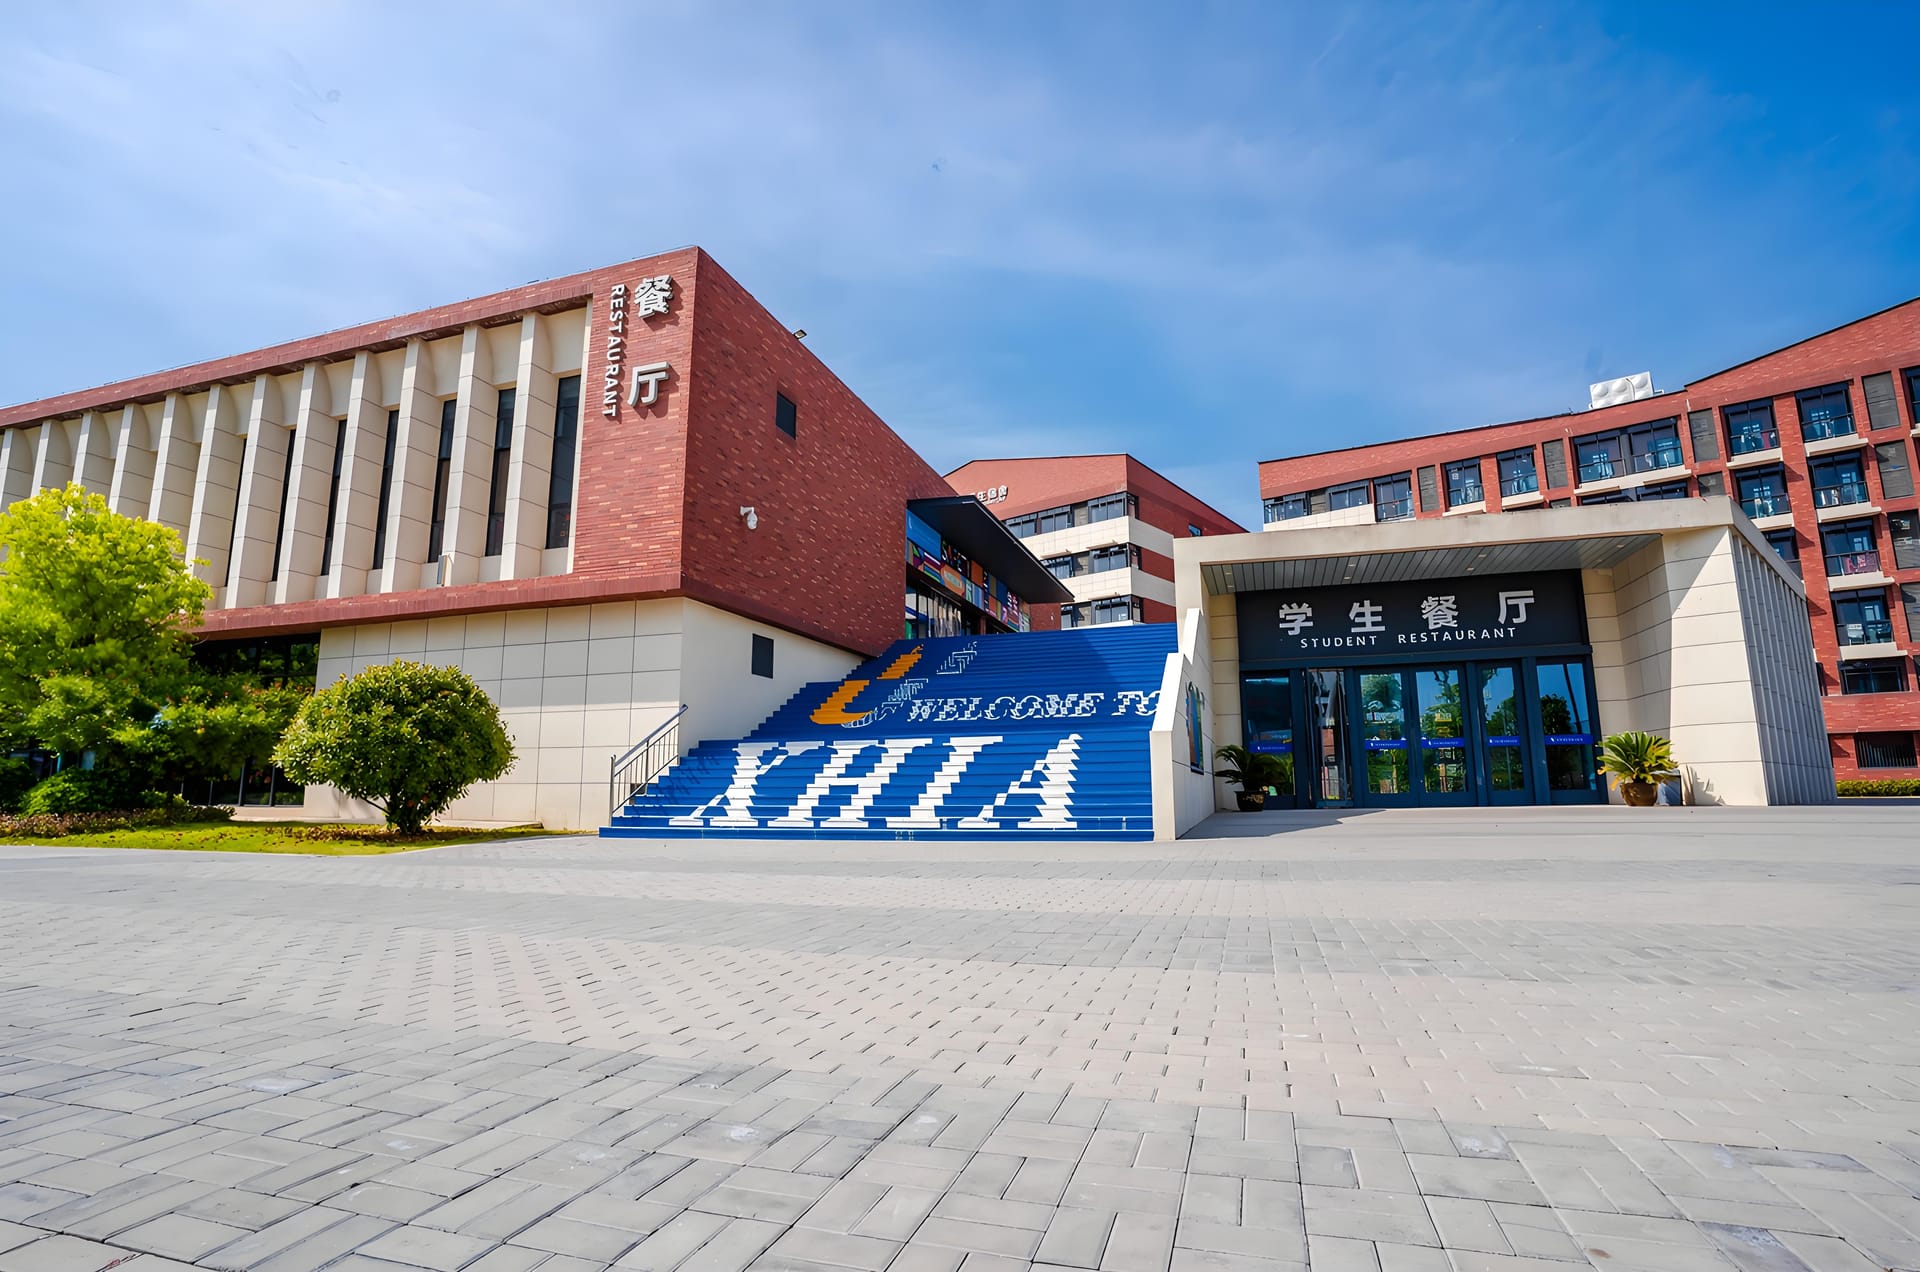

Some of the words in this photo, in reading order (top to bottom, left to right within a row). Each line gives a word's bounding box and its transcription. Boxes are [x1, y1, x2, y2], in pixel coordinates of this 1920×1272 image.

[602, 283, 625, 417] RESTAURANT
[627, 274, 673, 408] 餐厅
[1278, 590, 1535, 636] 学生餐厅
[1300, 635, 1378, 649] STUDENT
[1397, 627, 1517, 644] RESTAURANT
[907, 692, 1104, 722] WELCOME
